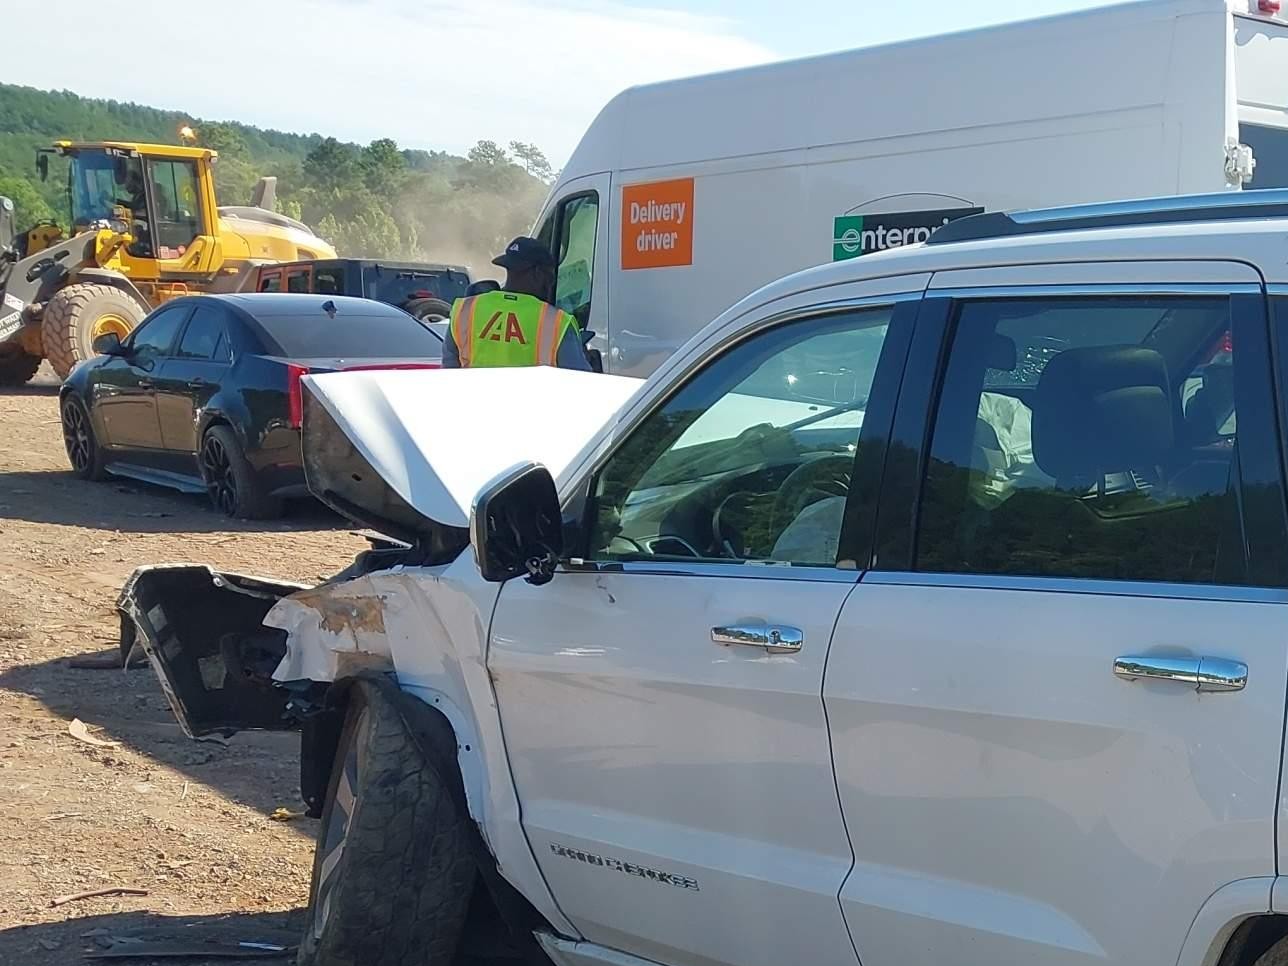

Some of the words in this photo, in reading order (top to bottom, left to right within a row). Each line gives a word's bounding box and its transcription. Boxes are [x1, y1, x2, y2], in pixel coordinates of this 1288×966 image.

[630, 200, 686, 224] Delivery
[636, 228, 678, 252] driver
[835, 217, 949, 252] enterp
